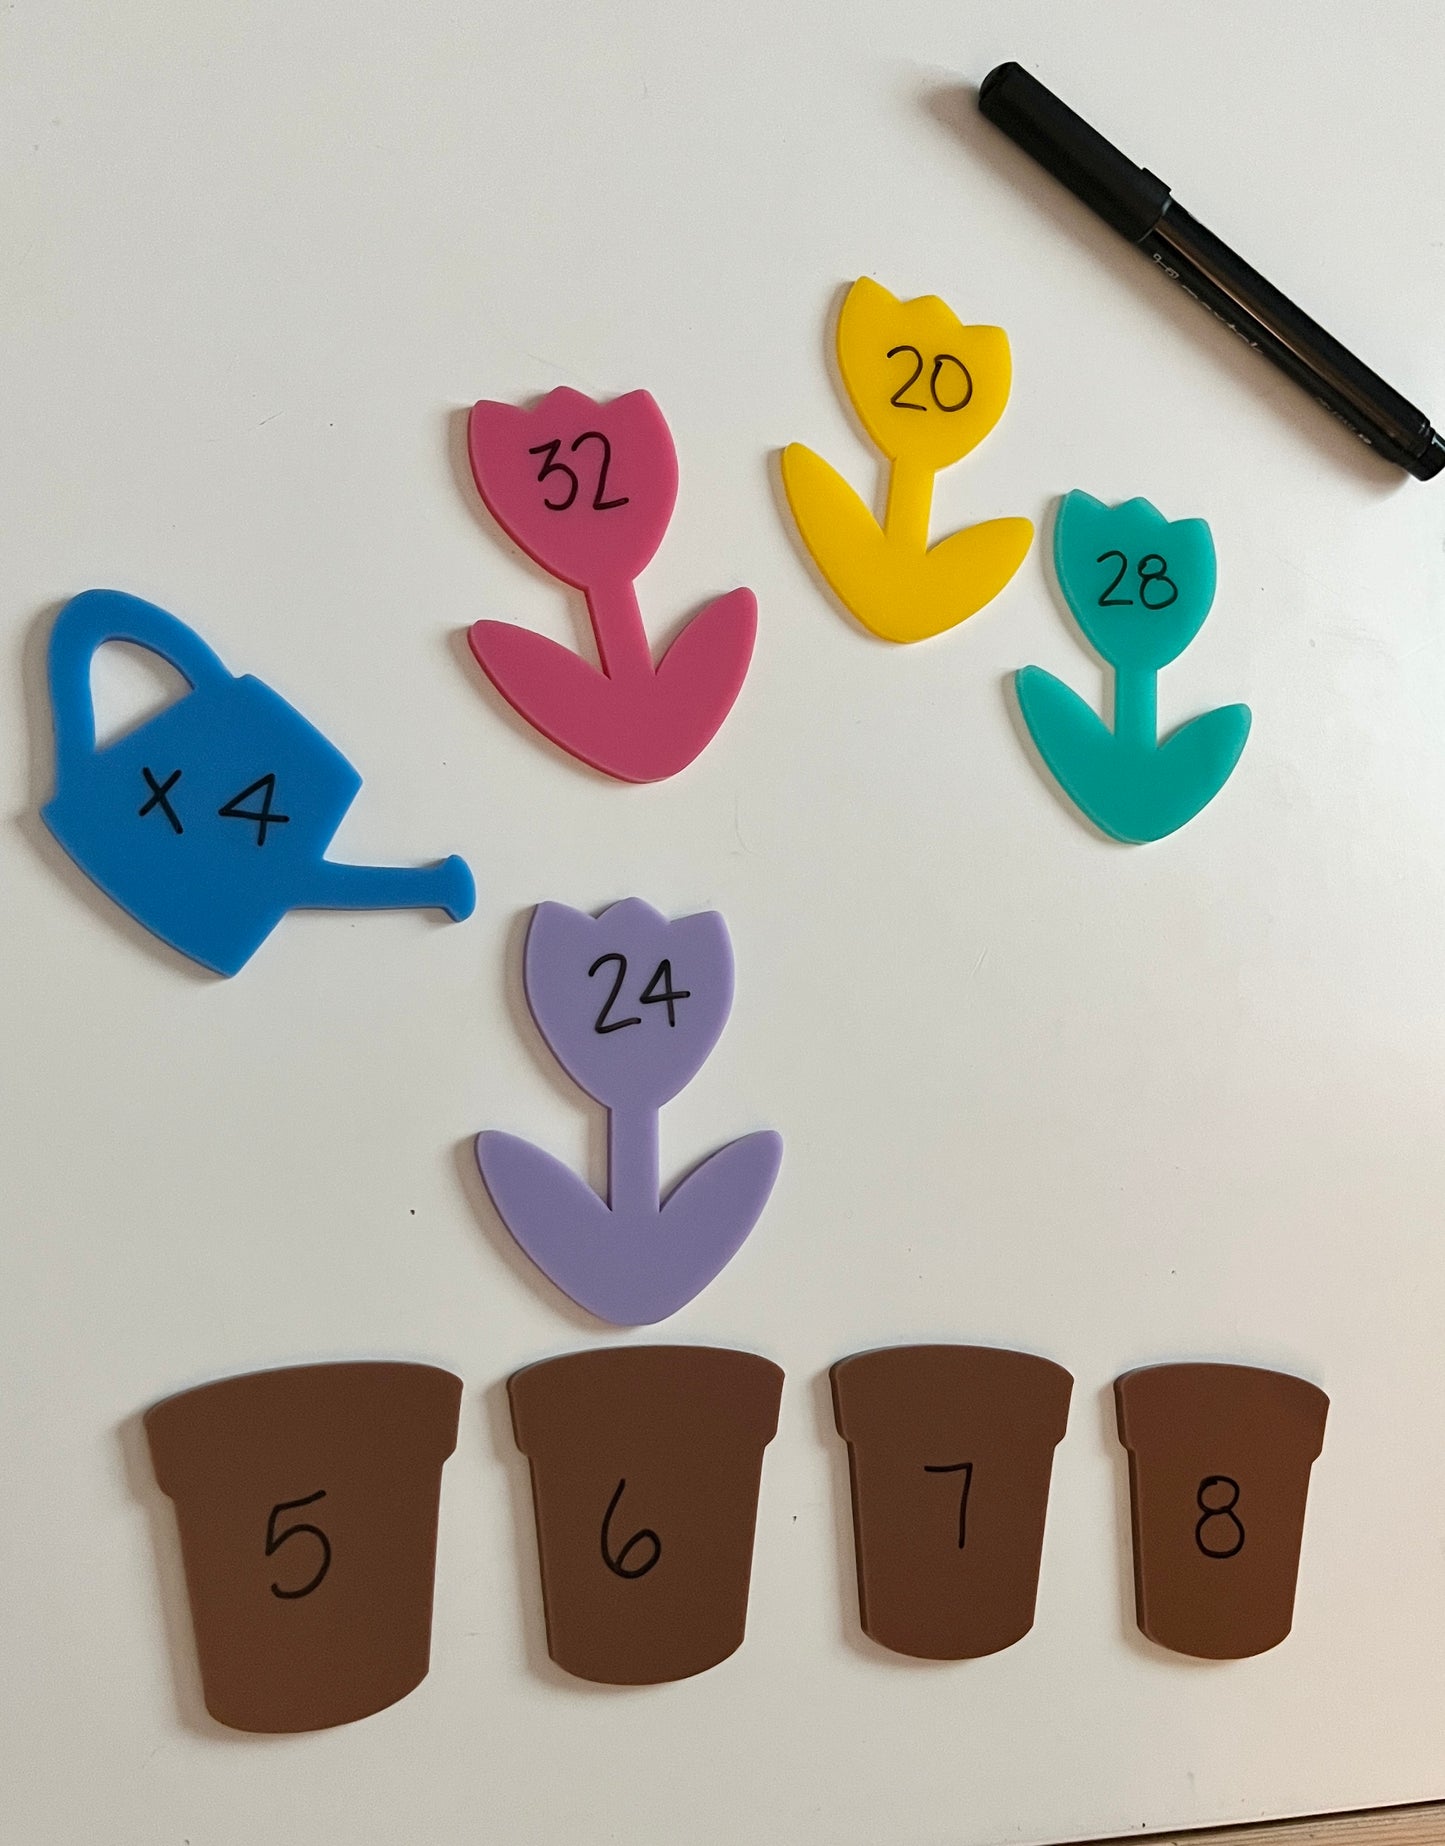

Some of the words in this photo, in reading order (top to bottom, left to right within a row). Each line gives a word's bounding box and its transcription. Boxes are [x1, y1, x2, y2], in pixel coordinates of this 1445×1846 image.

[887, 345, 973, 412] 20
[529, 431, 630, 512] 32
[1097, 551, 1178, 611] 28
[218, 773, 290, 847] 4
[588, 953, 691, 1035] 24
[265, 1490, 332, 1600] 5
[601, 1479, 662, 1580] 6
[924, 1463, 973, 1550] 7
[1196, 1476, 1245, 1560] 8
